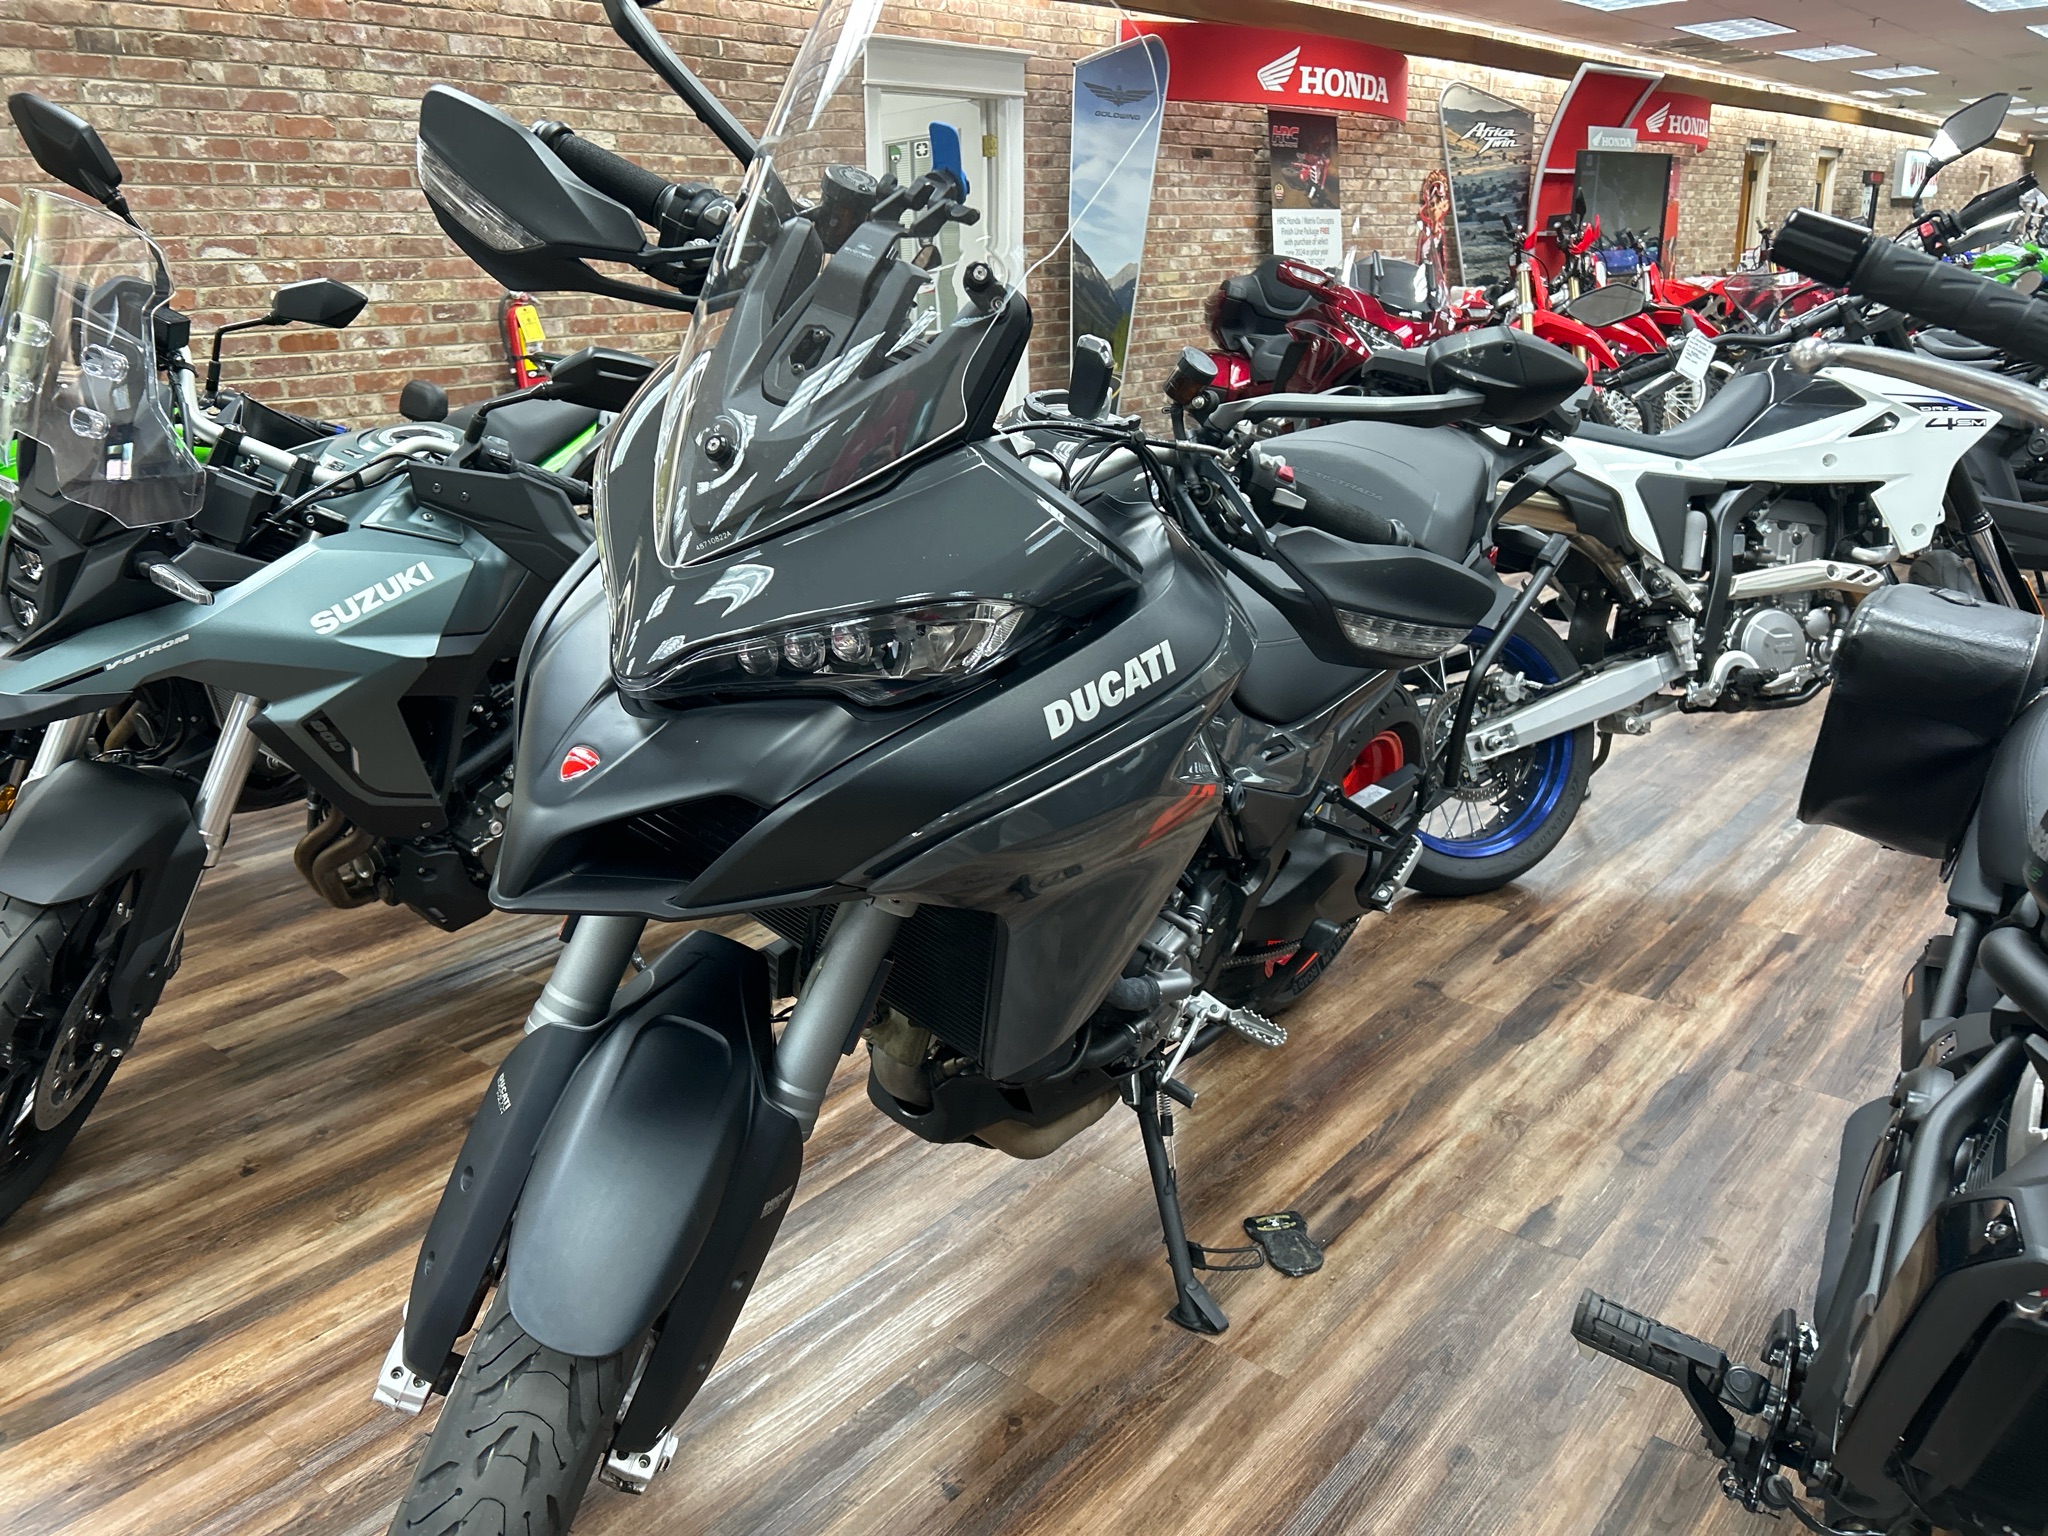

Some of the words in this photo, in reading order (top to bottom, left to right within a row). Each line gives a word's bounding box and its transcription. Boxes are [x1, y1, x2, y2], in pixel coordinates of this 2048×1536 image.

[1298, 65, 1389, 104] HONDA
[1094, 110, 1141, 121] GOLDWING
[1272, 125, 1300, 144] HRC
[1458, 121, 1521, 142] Africa
[1667, 114, 1709, 139] HONDA
[1477, 136, 1523, 156] Twin
[1601, 136, 1632, 148] HONDA
[1276, 216, 1286, 224] HRC
[1287, 216, 1301, 224] Honda
[1316, 216, 1334, 226] Concepts
[1294, 238, 1312, 247] purchase
[1304, 228, 1319, 236] Package
[695, 530, 732, 551] 48710822A
[309, 560, 436, 636] SUZUKI
[104, 632, 190, 671] V-STROM
[1043, 638, 1177, 741] DUCATI
[309, 719, 347, 754] 800
[1298, 965, 1320, 988] ROAD
[498, 1072, 511, 1110] DUCATI
